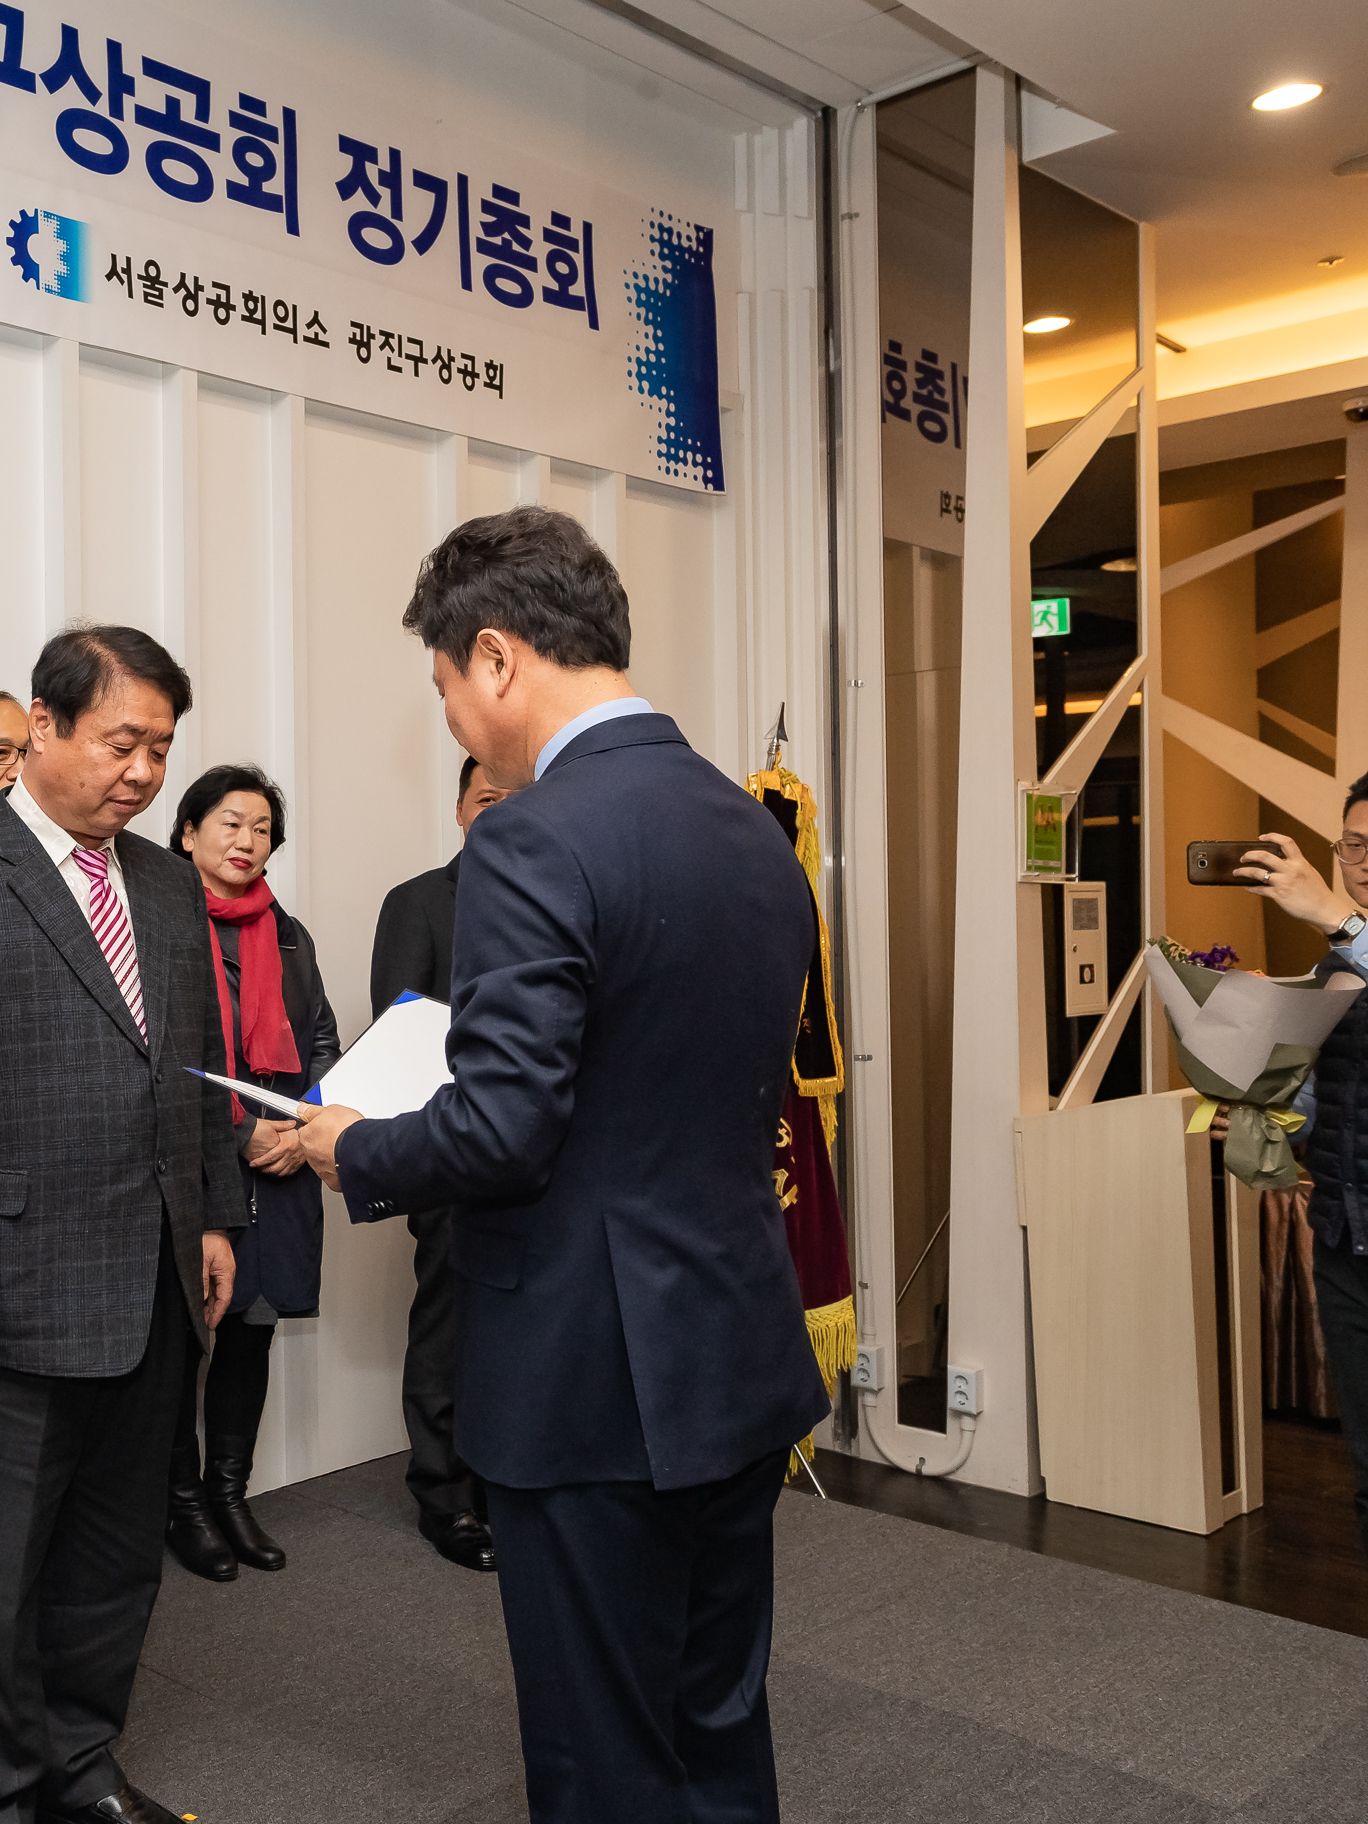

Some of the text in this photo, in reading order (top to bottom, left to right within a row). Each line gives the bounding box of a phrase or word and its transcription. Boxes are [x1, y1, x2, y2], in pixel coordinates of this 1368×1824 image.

[336, 132, 600, 331] 정기총회
[104, 252, 505, 400] 서울상공회의소 광진구상공회
